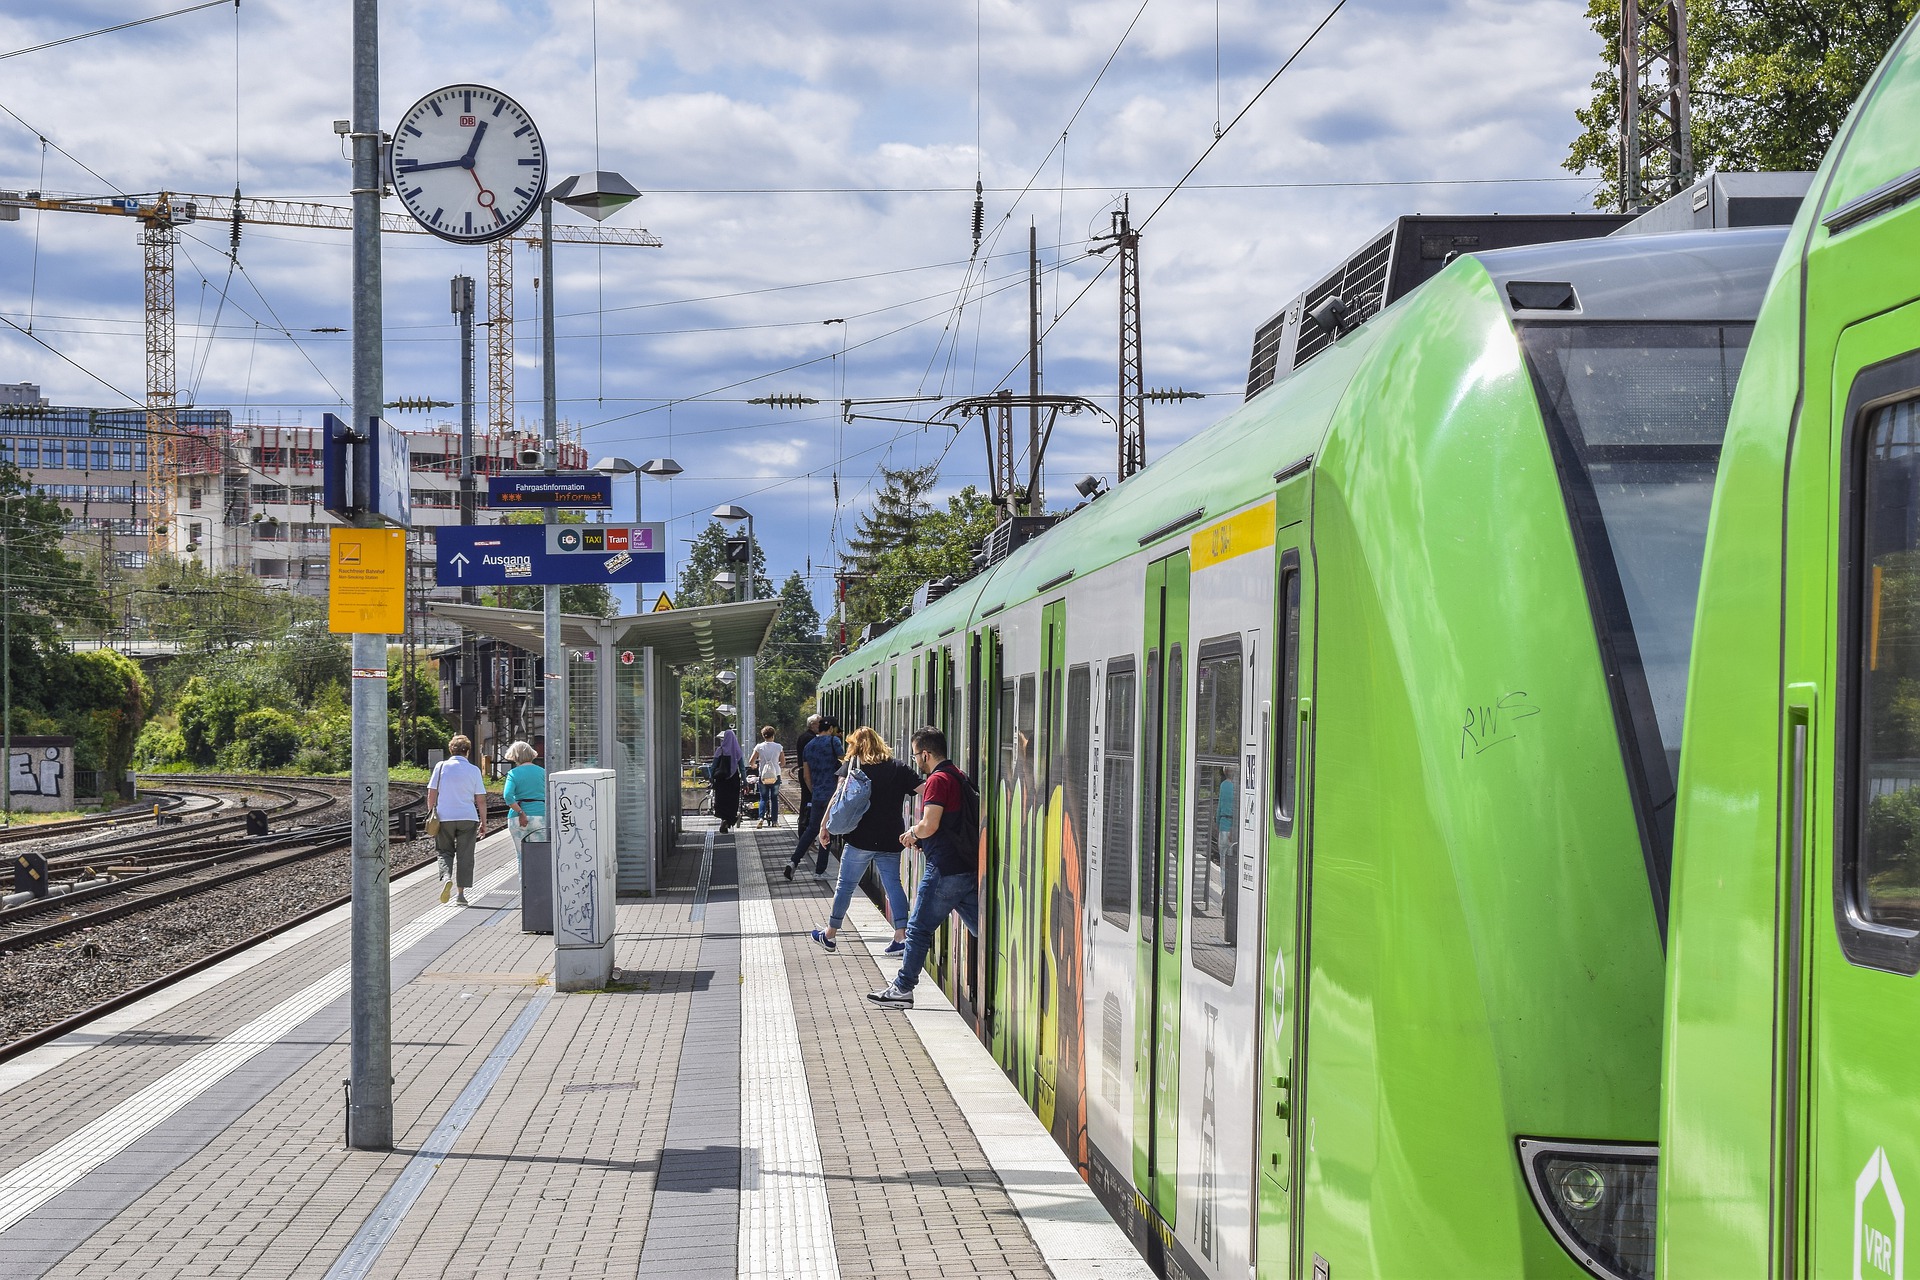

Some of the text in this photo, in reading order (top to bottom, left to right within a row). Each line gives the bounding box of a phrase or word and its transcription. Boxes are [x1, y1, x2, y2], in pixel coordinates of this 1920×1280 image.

[461, 117, 475, 125] DB
[515, 483, 585, 492] Fahrgastinformation
[584, 536, 602, 544] TAXI
[608, 535, 628, 544] Tram
[482, 554, 531, 566] Ausgang
[1310, 1116, 1316, 1153] 2
[1864, 1223, 1892, 1276] VRR
